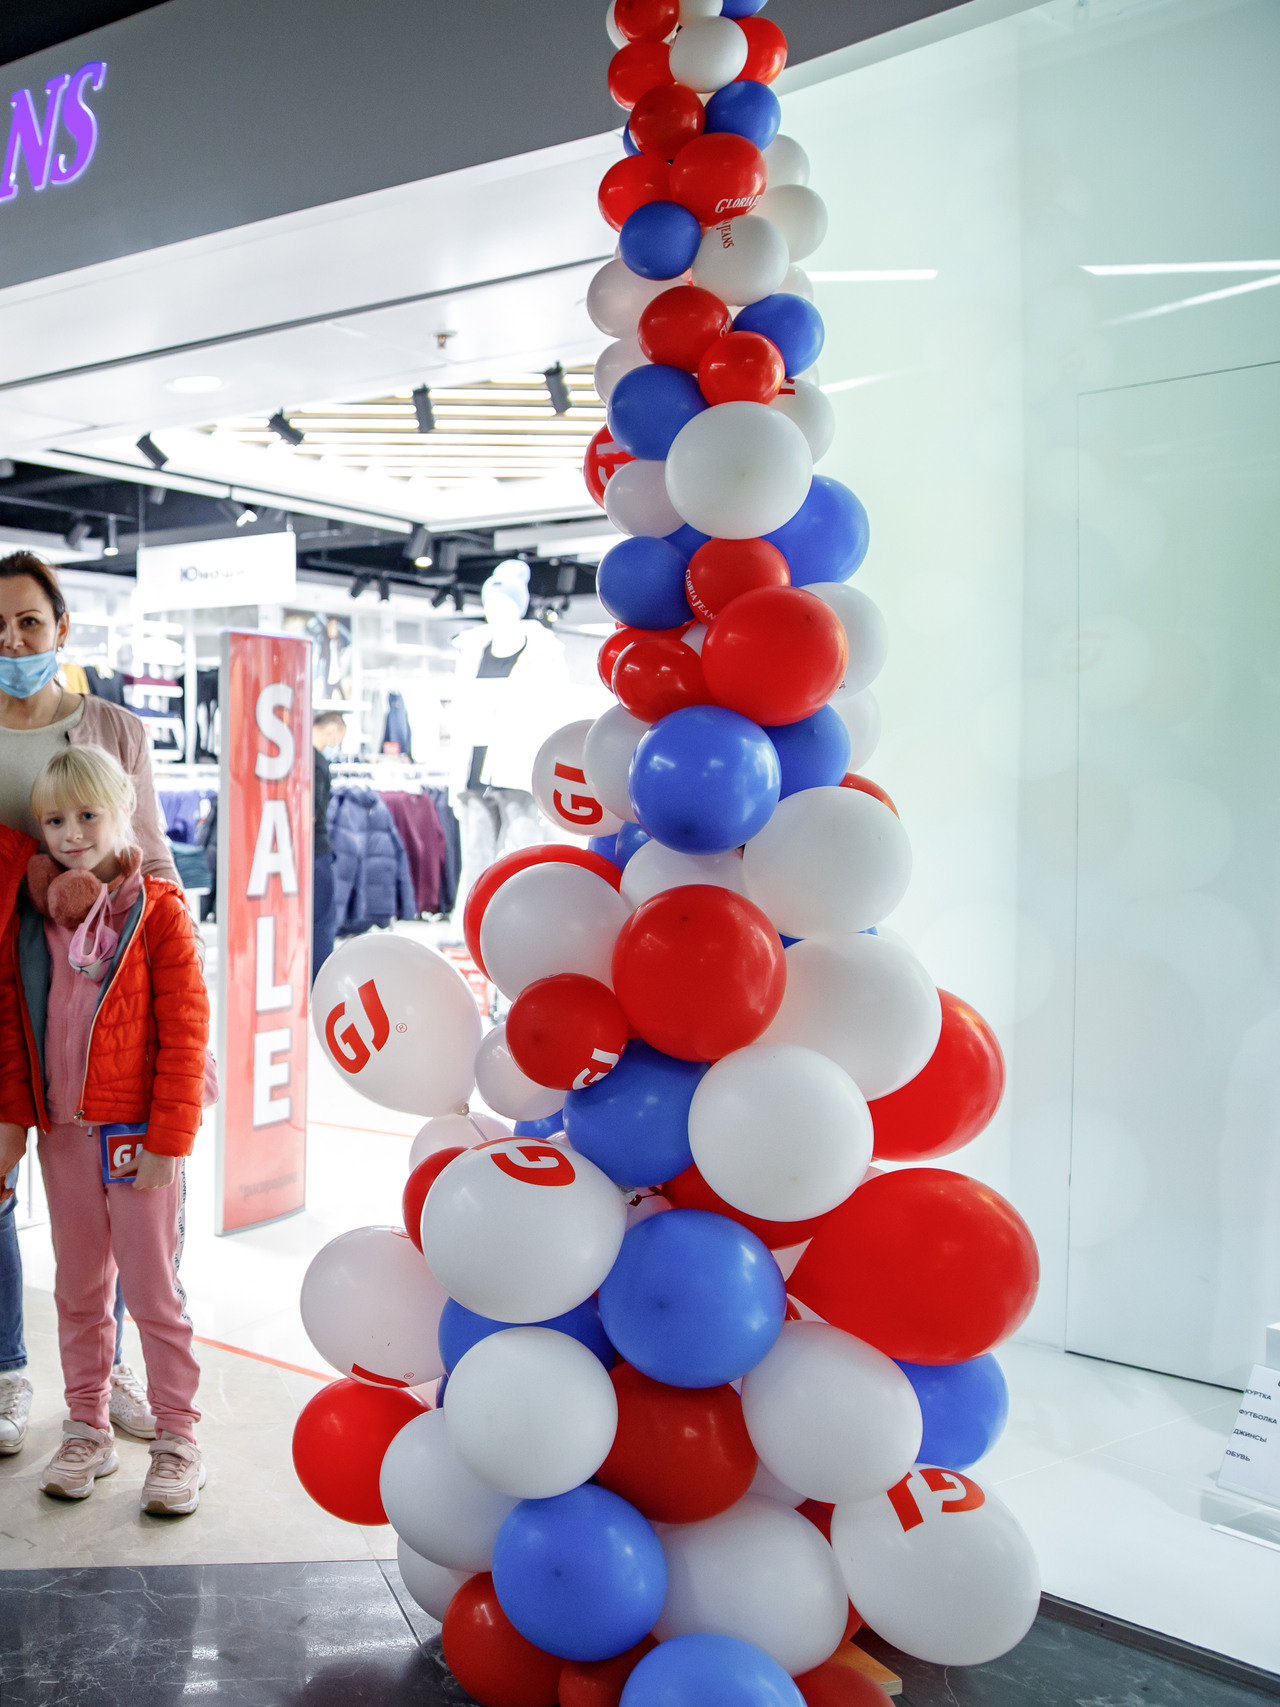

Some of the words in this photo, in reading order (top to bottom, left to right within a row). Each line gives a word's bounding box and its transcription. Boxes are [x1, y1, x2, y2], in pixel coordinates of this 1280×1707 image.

[691, 599, 717, 621] JEAN
[246, 682, 299, 1131] SALE
[324, 978, 390, 1074] GJ
[1244, 1388, 1273, 1400] КУРТКА
[1238, 1408, 1278, 1425] ФУТБОЛКА
[1232, 1428, 1268, 1443] ДЖИНСЫ
[1225, 1449, 1251, 1462] ОБУВЬ
[886, 1467, 986, 1533] GJ
